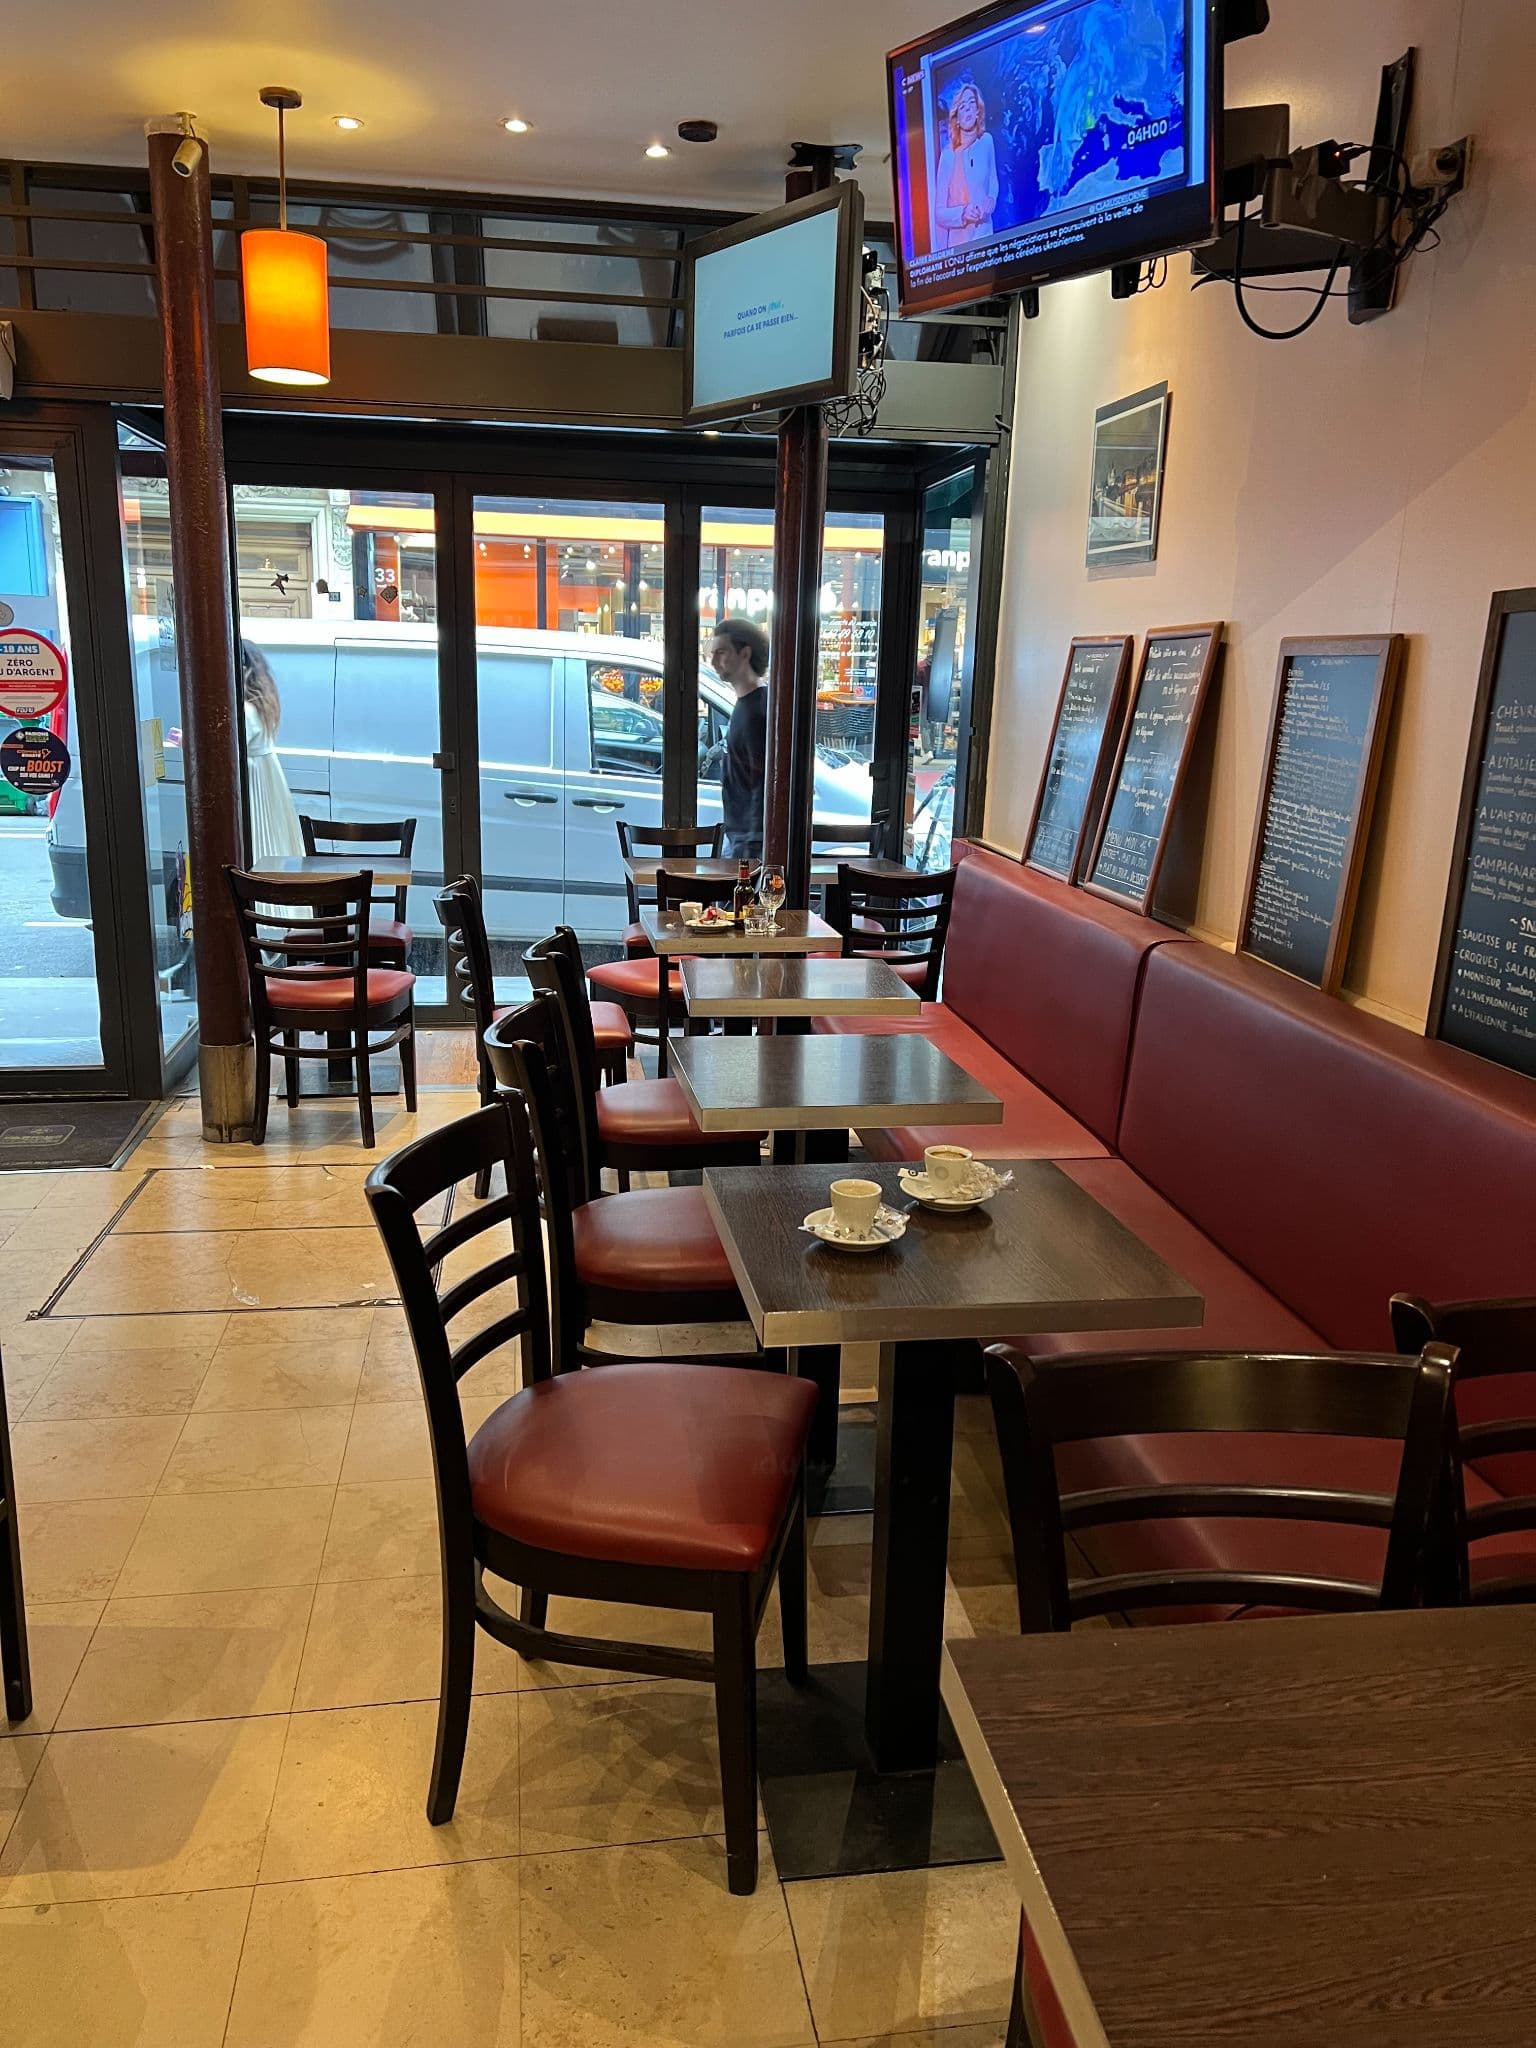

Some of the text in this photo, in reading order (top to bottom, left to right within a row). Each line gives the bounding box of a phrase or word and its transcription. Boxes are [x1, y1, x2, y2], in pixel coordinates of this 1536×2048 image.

[1127, 119, 1168, 146] 04H00
[987, 246, 999, 258] que
[737, 305, 758, 320] QUAND
[758, 304, 767, 314] ON
[375, 567, 396, 583] 33
[17, 644, 38, 654] ANS
[6, 658, 33, 667] ZÉRO
[6, 668, 55, 676] D'ARGENT
[1496, 699, 1536, 719] CHÈVR
[27, 760, 64, 773] BOOST
[1462, 928, 1501, 949] SAUCISSE
[1506, 940, 1519, 953] DE
[1463, 968, 1502, 990] MONSIEUR
